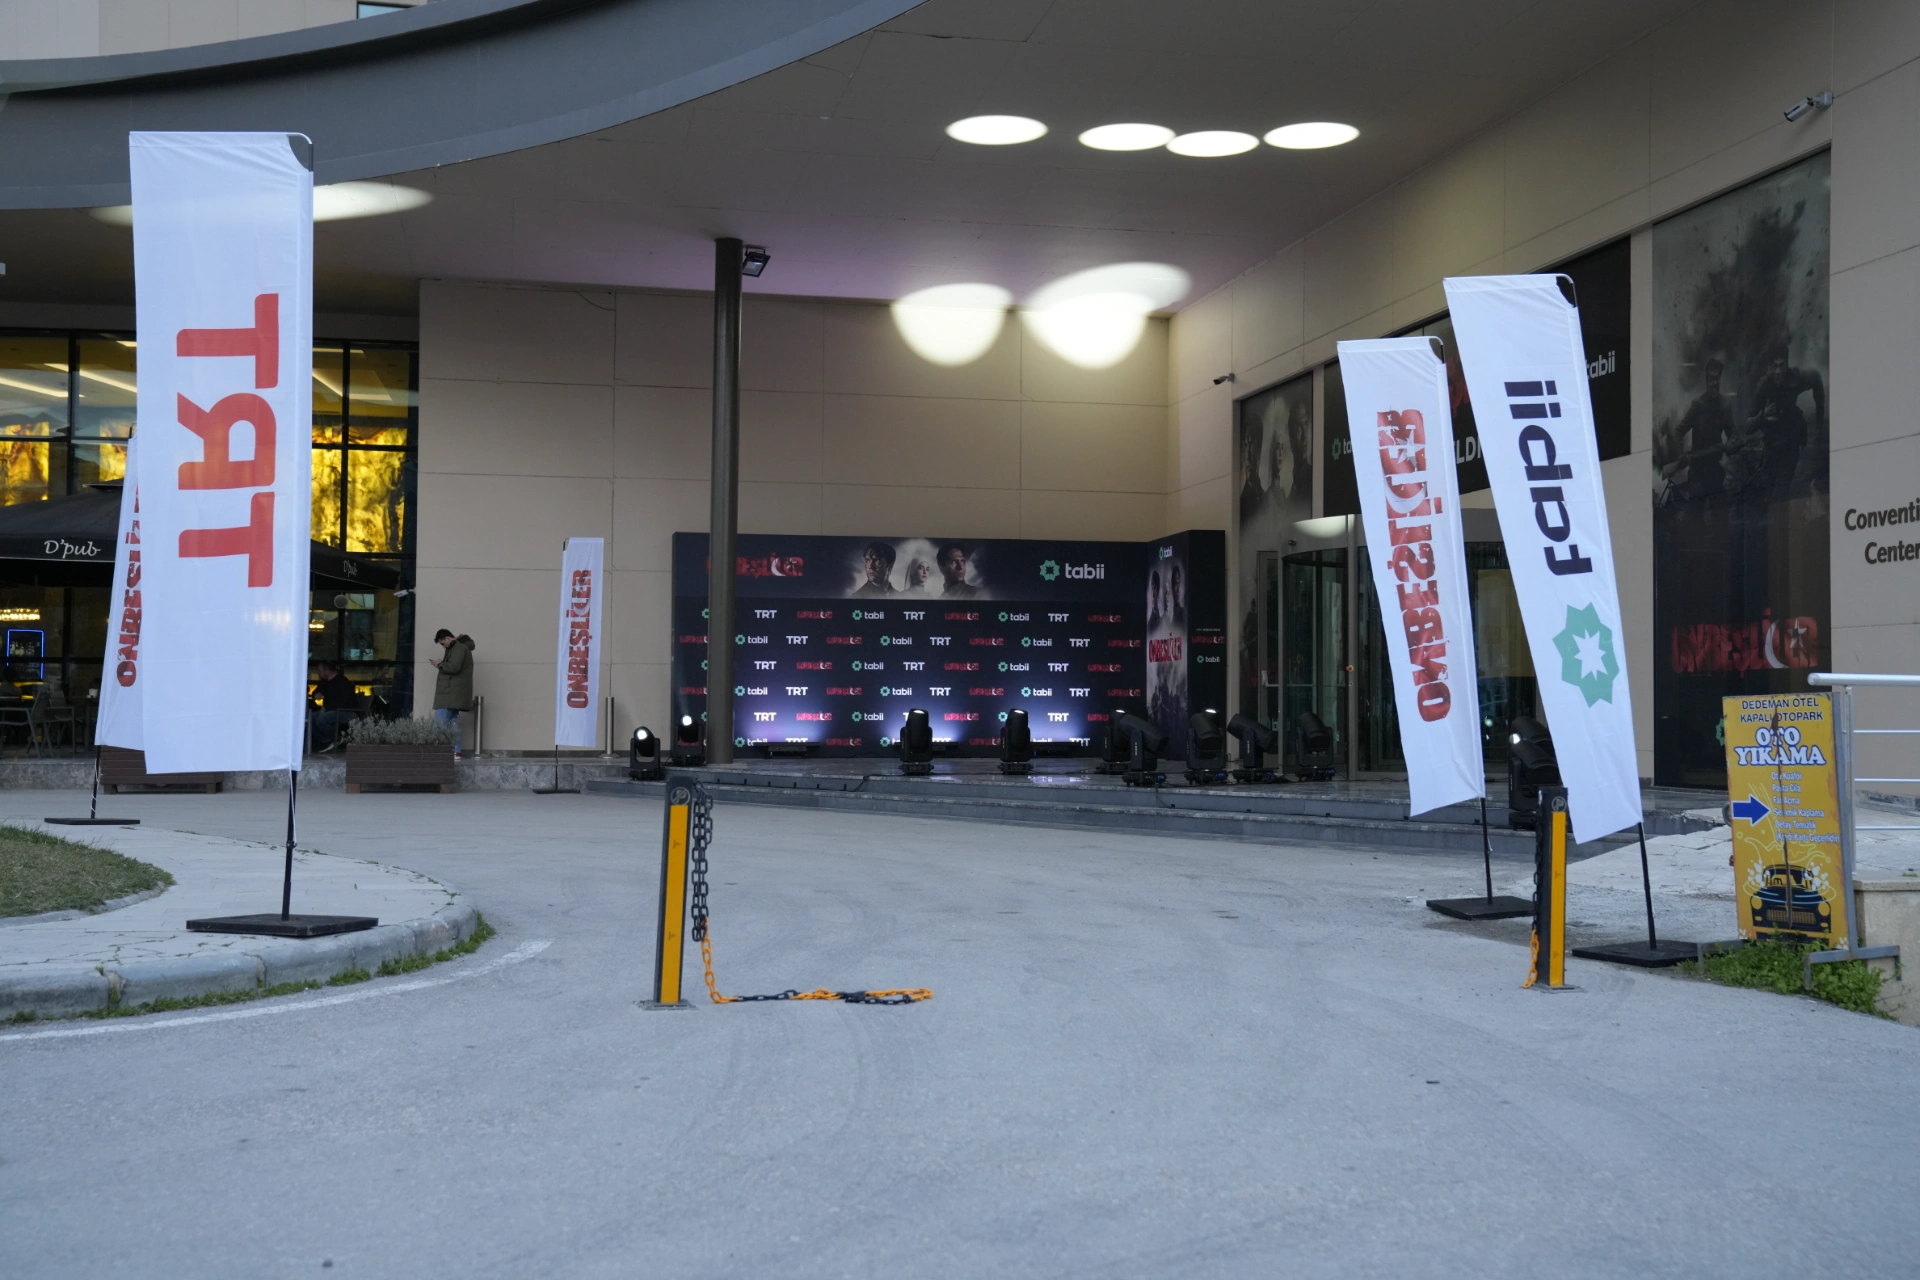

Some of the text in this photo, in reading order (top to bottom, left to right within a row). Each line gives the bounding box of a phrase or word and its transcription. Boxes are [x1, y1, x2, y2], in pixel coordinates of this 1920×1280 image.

[1865, 540, 1920, 565] Center
[1064, 563, 1105, 579] tabii
[754, 610, 777, 618] TRT
[864, 610, 884, 619] tabii
[904, 612, 925, 620] TRT
[1010, 612, 1030, 621] tabii
[1048, 613, 1069, 622] TRT
[566, 569, 592, 709] ONBEŞLİLER
[747, 636, 768, 644] tabii
[786, 636, 808, 644] TRT
[892, 637, 912, 645] tabii
[930, 637, 951, 646] TRT
[1033, 638, 1052, 647] tabii
[1069, 639, 1090, 647] TRT
[754, 661, 776, 670] TRT
[864, 662, 884, 670] tabii
[903, 662, 925, 671] TRT
[1009, 663, 1029, 671] tabii
[1048, 663, 1069, 672] TRT
[747, 687, 768, 696] tabii
[786, 687, 808, 696] TRT
[892, 687, 912, 696] tabii
[930, 687, 951, 696] TRT
[1033, 688, 1052, 696] tabii
[1069, 688, 1090, 697] TRT
[1742, 697, 1819, 710] DEDEMAN OTEL
[754, 712, 776, 721] TRT
[864, 712, 884, 721] tabii
[1048, 713, 1069, 721] TRT
[1777, 711, 1823, 722] OTOPARK
[1755, 726, 1801, 746] OTO
[1734, 745, 1826, 766] YIKAMA
